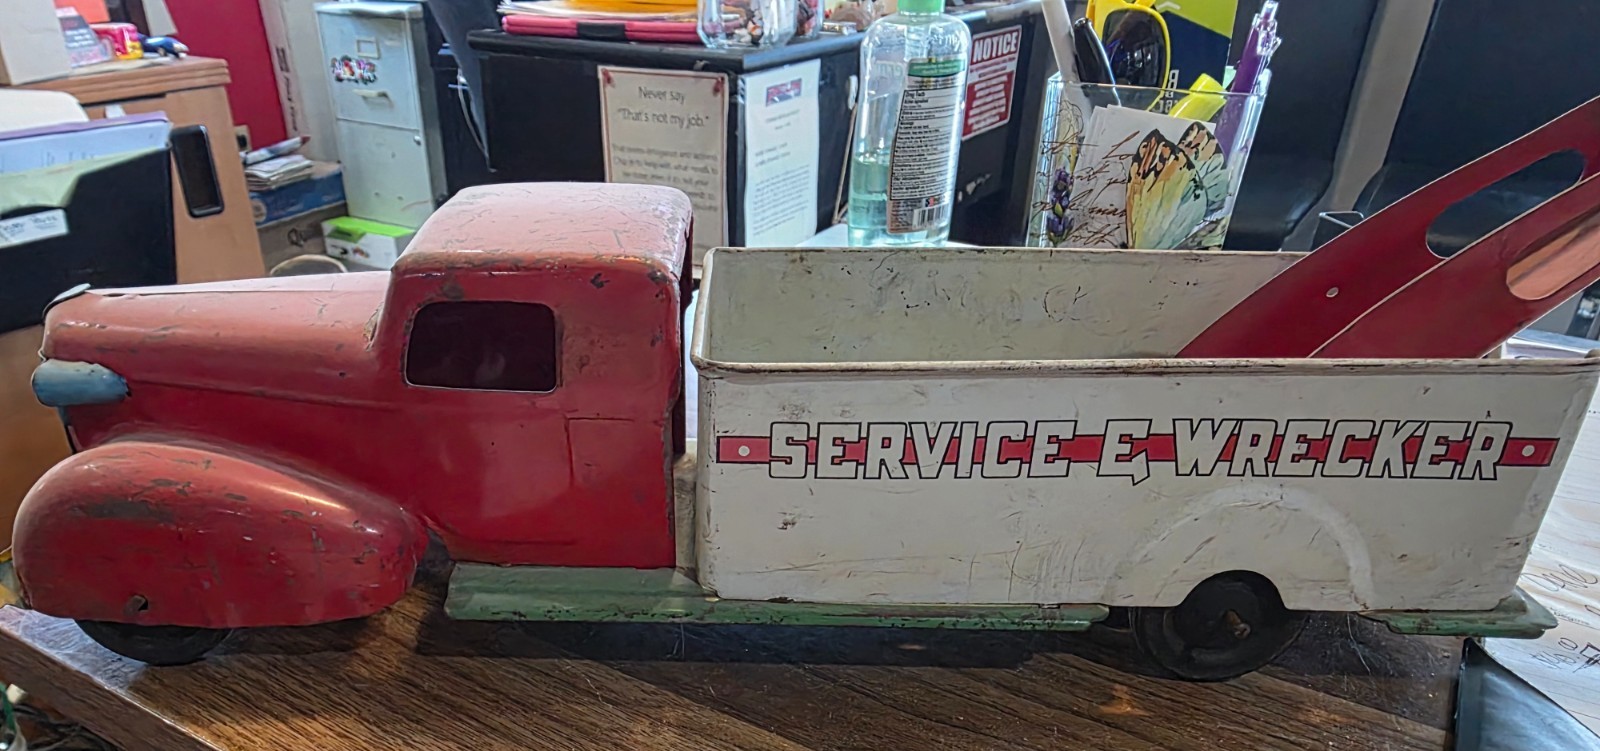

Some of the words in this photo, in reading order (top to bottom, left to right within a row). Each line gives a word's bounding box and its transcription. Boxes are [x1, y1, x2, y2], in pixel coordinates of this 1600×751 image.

[973, 31, 1018, 63] NOTICE
[638, 86, 667, 101] Never
[670, 90, 685, 105] say
[652, 113, 668, 124] not
[669, 115, 685, 129] my
[769, 420, 1078, 480] SERVICE
[1173, 418, 1513, 481] WRECKER
